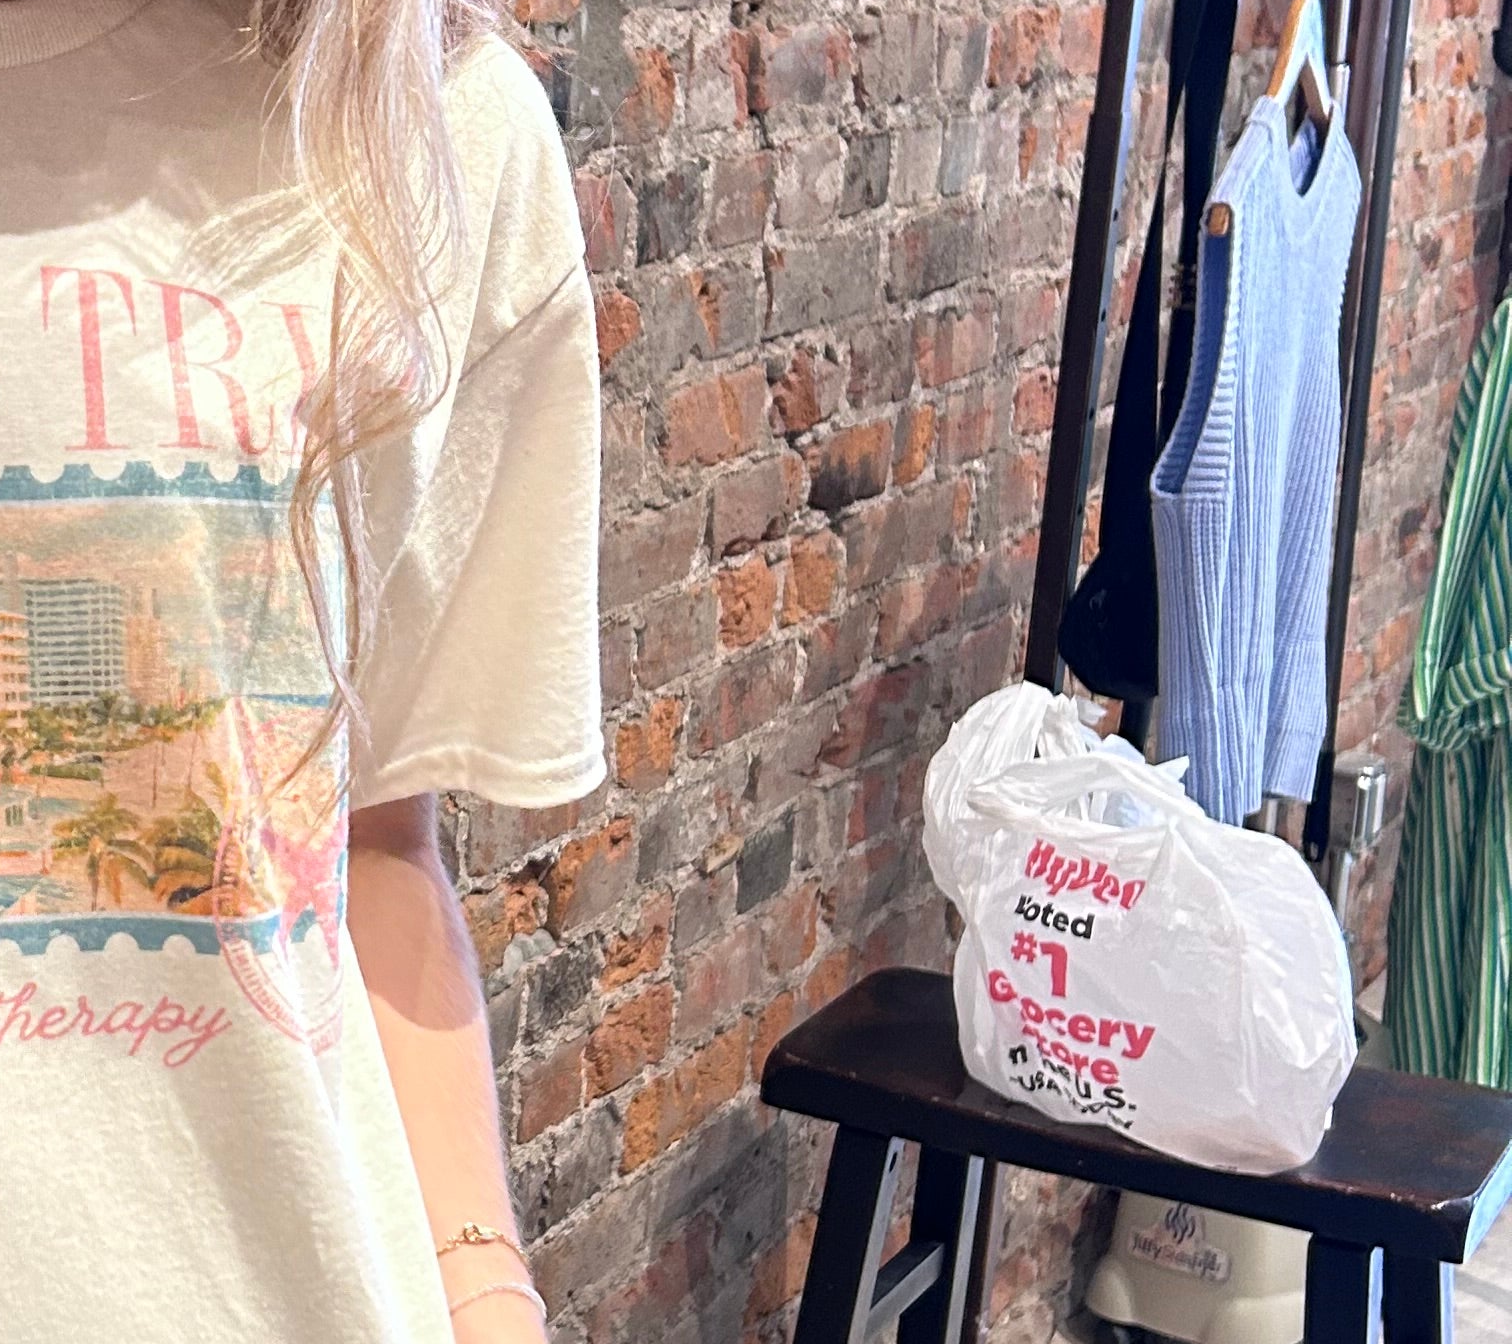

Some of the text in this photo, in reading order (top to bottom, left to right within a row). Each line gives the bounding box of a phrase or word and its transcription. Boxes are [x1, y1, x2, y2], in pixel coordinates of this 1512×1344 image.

[40, 264, 333, 458] TRI
[1010, 930, 1069, 999] #1
[988, 969, 1156, 1060] Gocery
